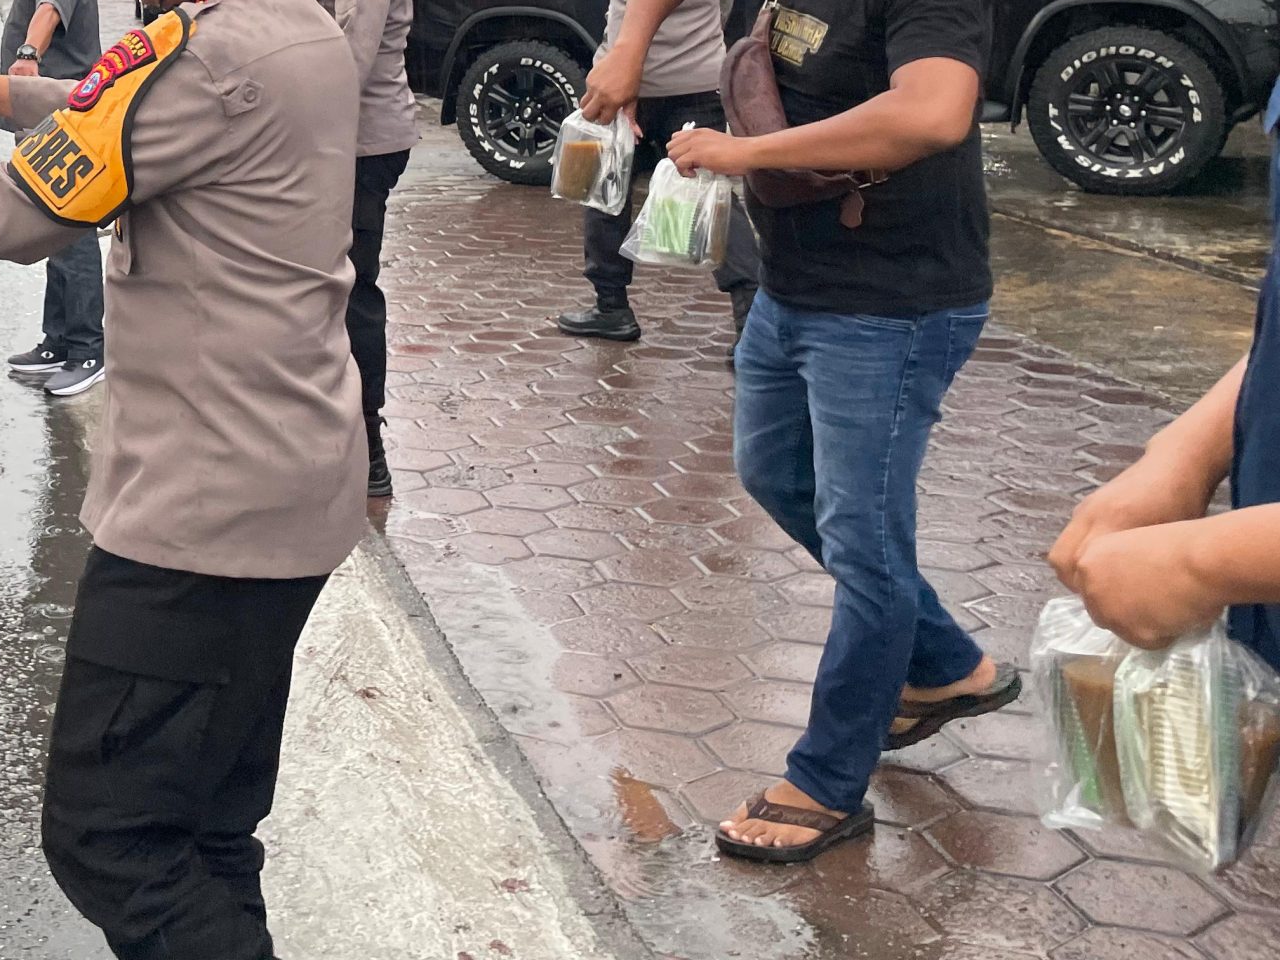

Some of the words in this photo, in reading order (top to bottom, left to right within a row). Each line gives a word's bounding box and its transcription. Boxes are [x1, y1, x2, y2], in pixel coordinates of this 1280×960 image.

[520, 57, 580, 109] BIGHOR
[1060, 45, 1174, 82] BIGHORN
[469, 102, 526, 170] MAXXIS
[1074, 146, 1186, 178] MAXXIS
